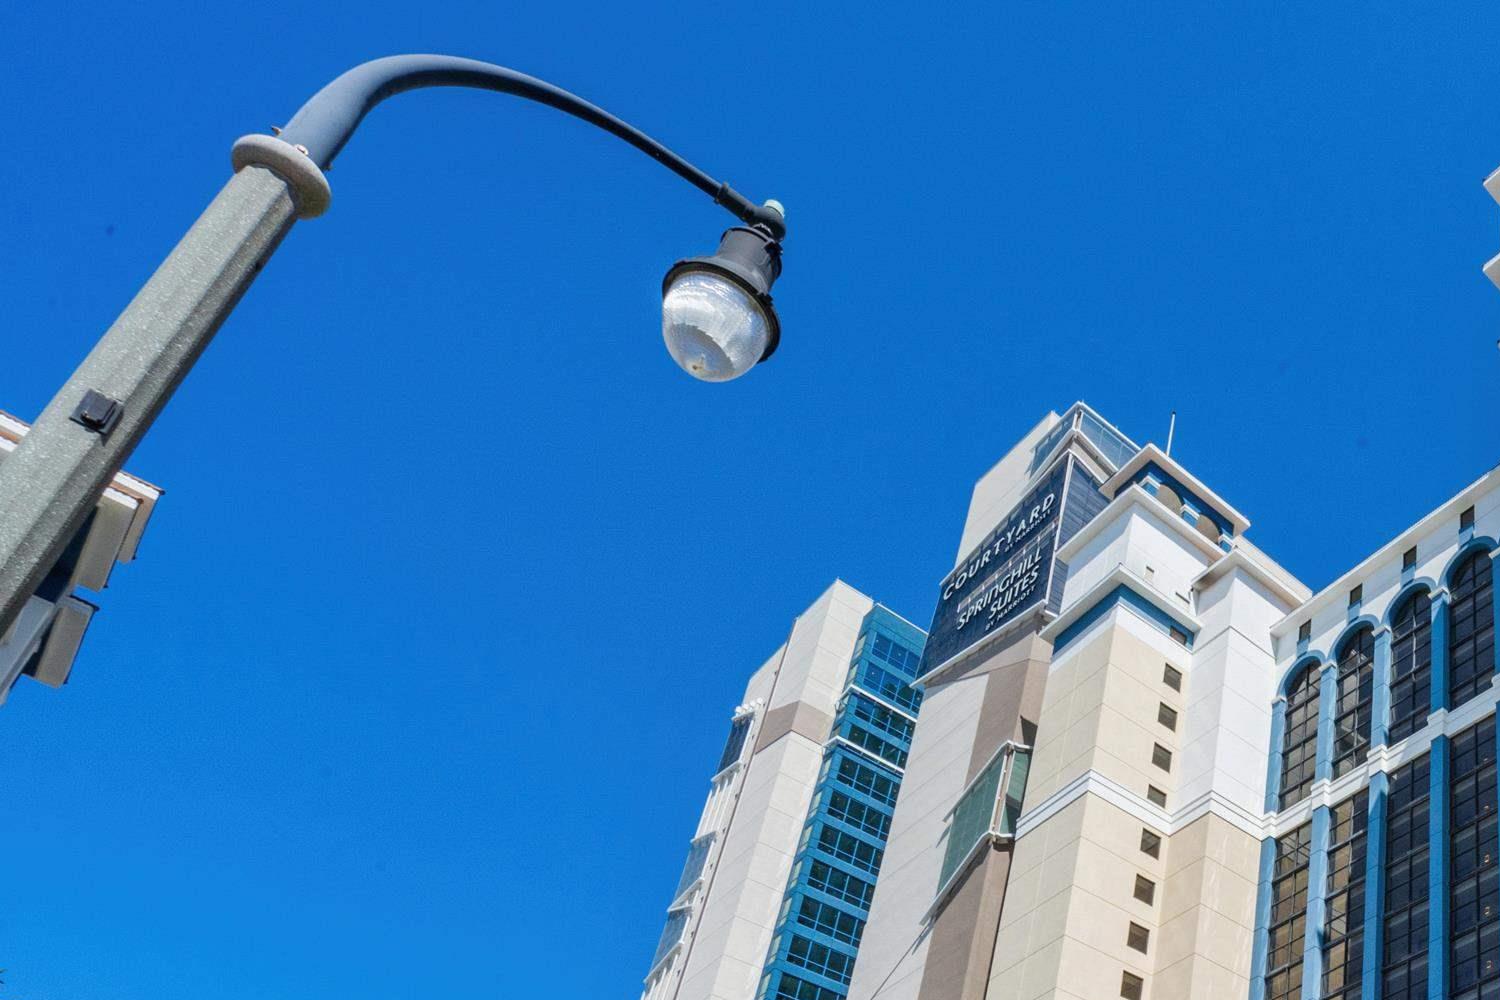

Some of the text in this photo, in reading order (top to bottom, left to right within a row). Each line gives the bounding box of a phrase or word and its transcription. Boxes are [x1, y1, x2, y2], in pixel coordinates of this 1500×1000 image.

[943, 493, 1055, 600] COURTYARD
[989, 565, 1039, 618] SUITES
[996, 584, 1036, 621] MARRIOTT
